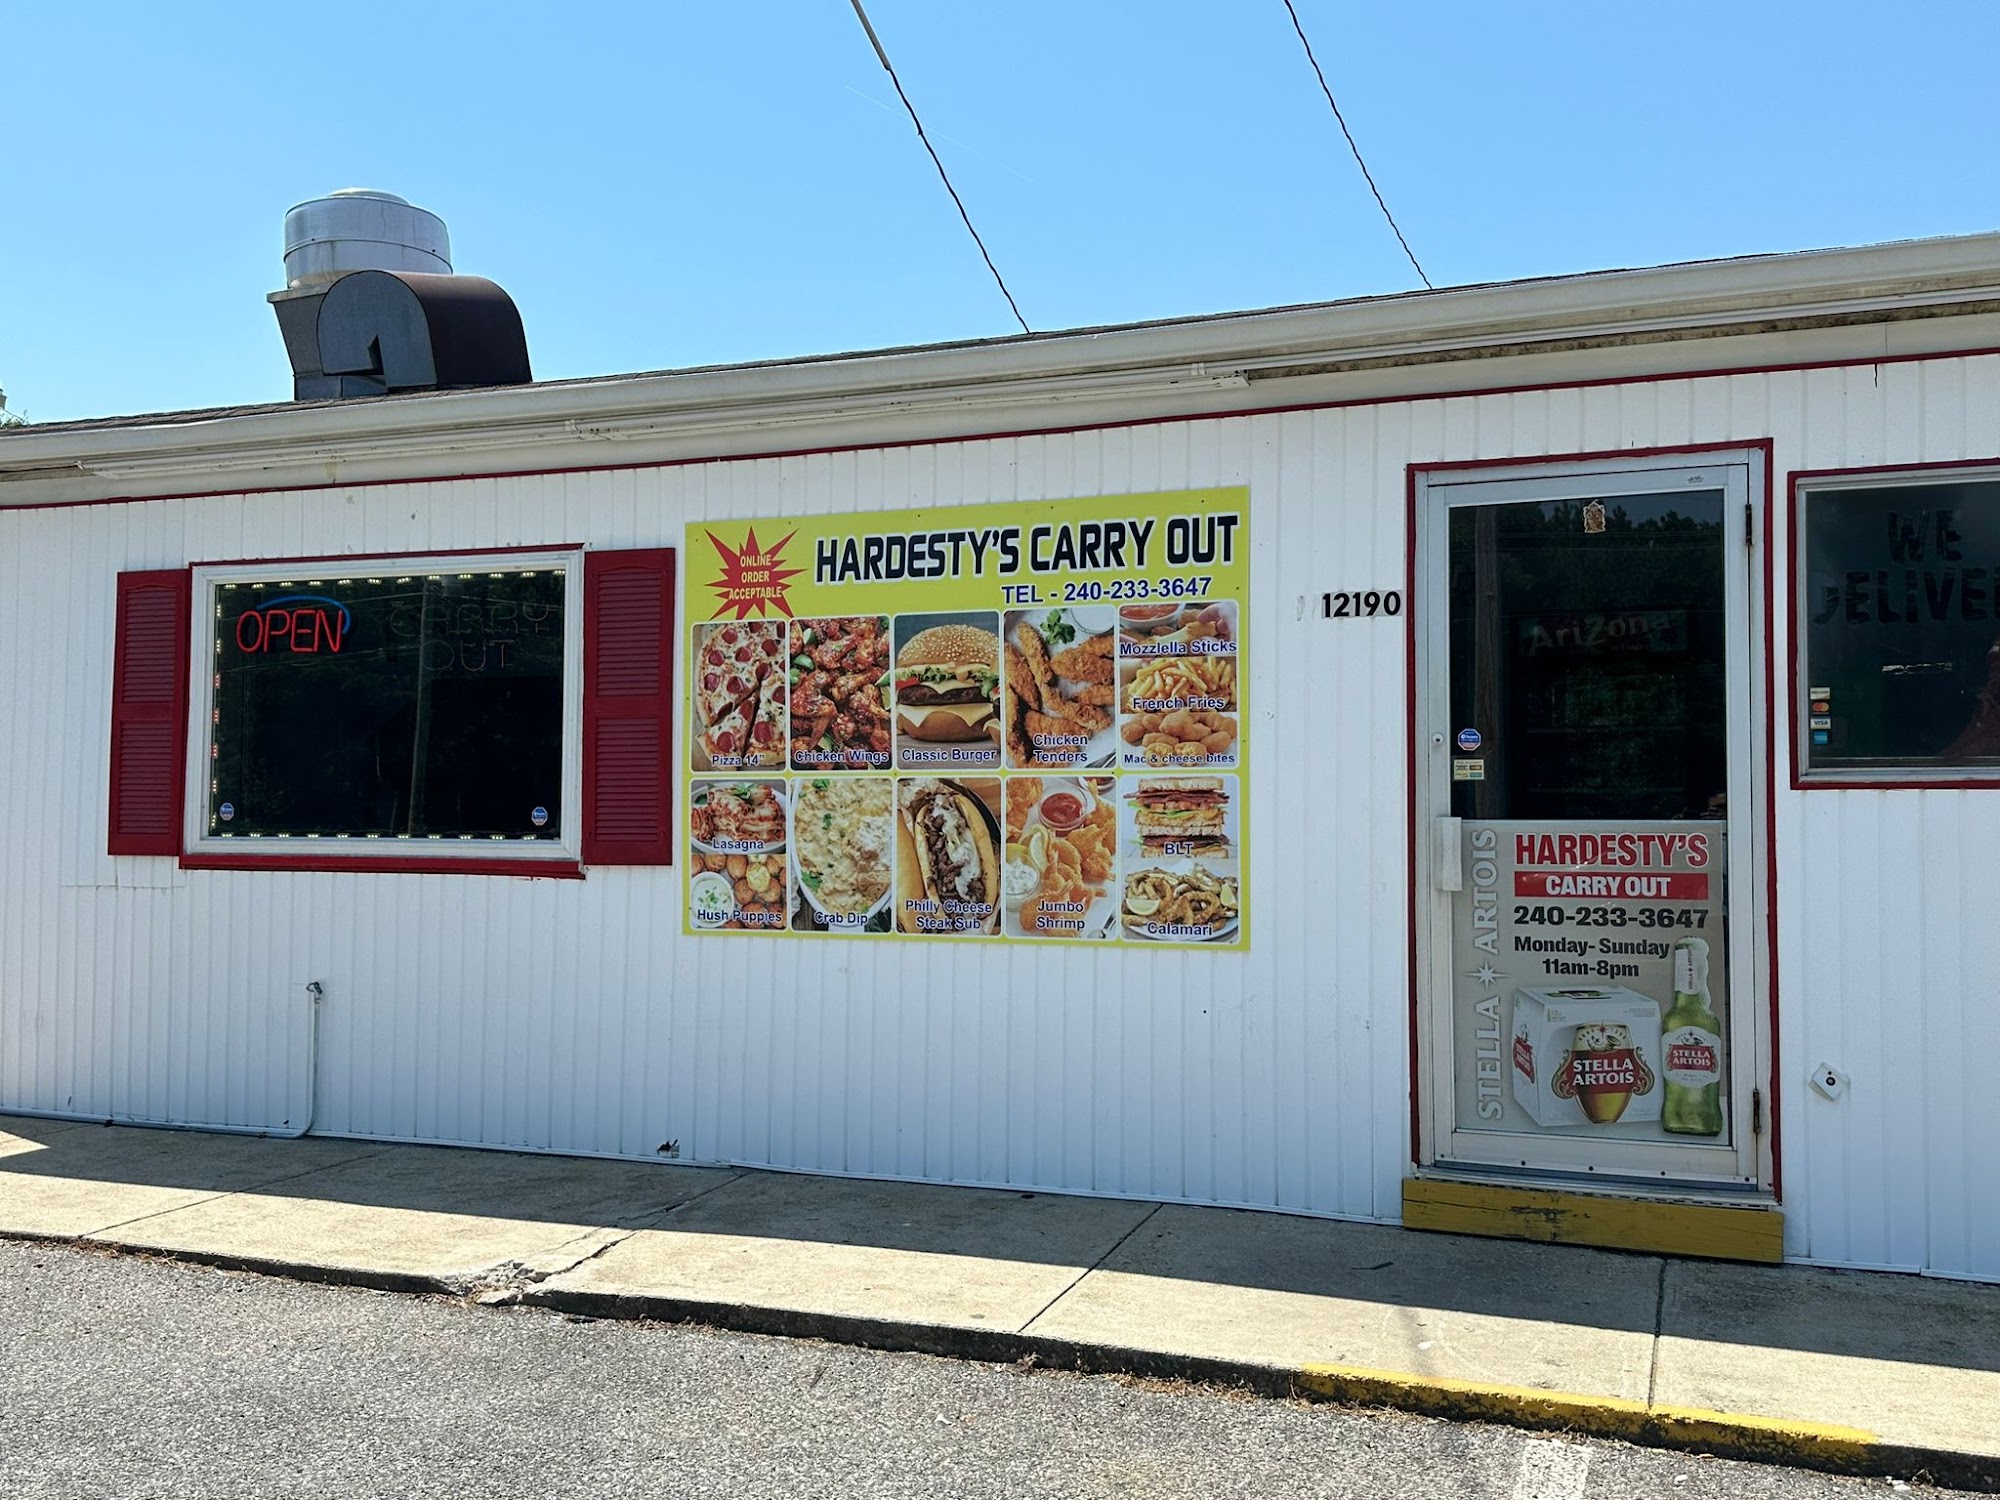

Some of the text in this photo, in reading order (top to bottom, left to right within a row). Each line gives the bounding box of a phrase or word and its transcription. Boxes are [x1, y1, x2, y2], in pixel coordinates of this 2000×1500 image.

[1888, 510, 1964, 563] WE
[815, 515, 1238, 583] HARDESTY'S CARRY OUT
[740, 554, 772, 567] ONLINE
[741, 570, 770, 584] ORDER
[728, 586, 782, 601] ACCEPTABLE
[1001, 585, 1044, 604] TEL
[1063, 577, 1212, 601] 240-233-3647
[1812, 568, 2000, 625] ELIVE
[1322, 591, 1401, 618] 12190
[236, 608, 343, 653] OPEN
[1120, 640, 1237, 655] Mozzlella Sticks
[421, 638, 515, 672] OUT
[1133, 696, 1225, 709] French Fries
[1033, 734, 1088, 746] Chicken
[712, 754, 741, 766] Pizza
[795, 751, 889, 764] Chicken Wings
[902, 749, 997, 763] Classic Burger
[1033, 751, 1088, 763] Tenders
[1124, 754, 1235, 764] Mac & cheese bites
[713, 839, 764, 851] Lasagna
[1165, 843, 1193, 855] BLT
[1515, 834, 1709, 867] HARDESTY'S
[1546, 875, 1671, 897] CARRY OUT
[905, 900, 992, 914] Philly Cheese
[1038, 900, 1084, 912] Jumbo
[697, 909, 782, 924] Hush Puppies
[814, 912, 868, 924] Crab Dip
[916, 917, 981, 929] Steak Sub
[1036, 917, 1085, 930] Shrimp
[1514, 906, 1709, 928] 240-233-3647
[1147, 922, 1212, 935] Calamari
[1514, 936, 1670, 959] Monday- Sunday
[1471, 829, 1502, 1120] STELLA ARTOIS
[1542, 959, 1639, 979] 11am-8pm
[1672, 1049, 1711, 1059] STELLA
[1573, 1058, 1634, 1072] STELLA
[1672, 1057, 1711, 1067] ARTOIS
[1572, 1071, 1635, 1086] ARTOIS
